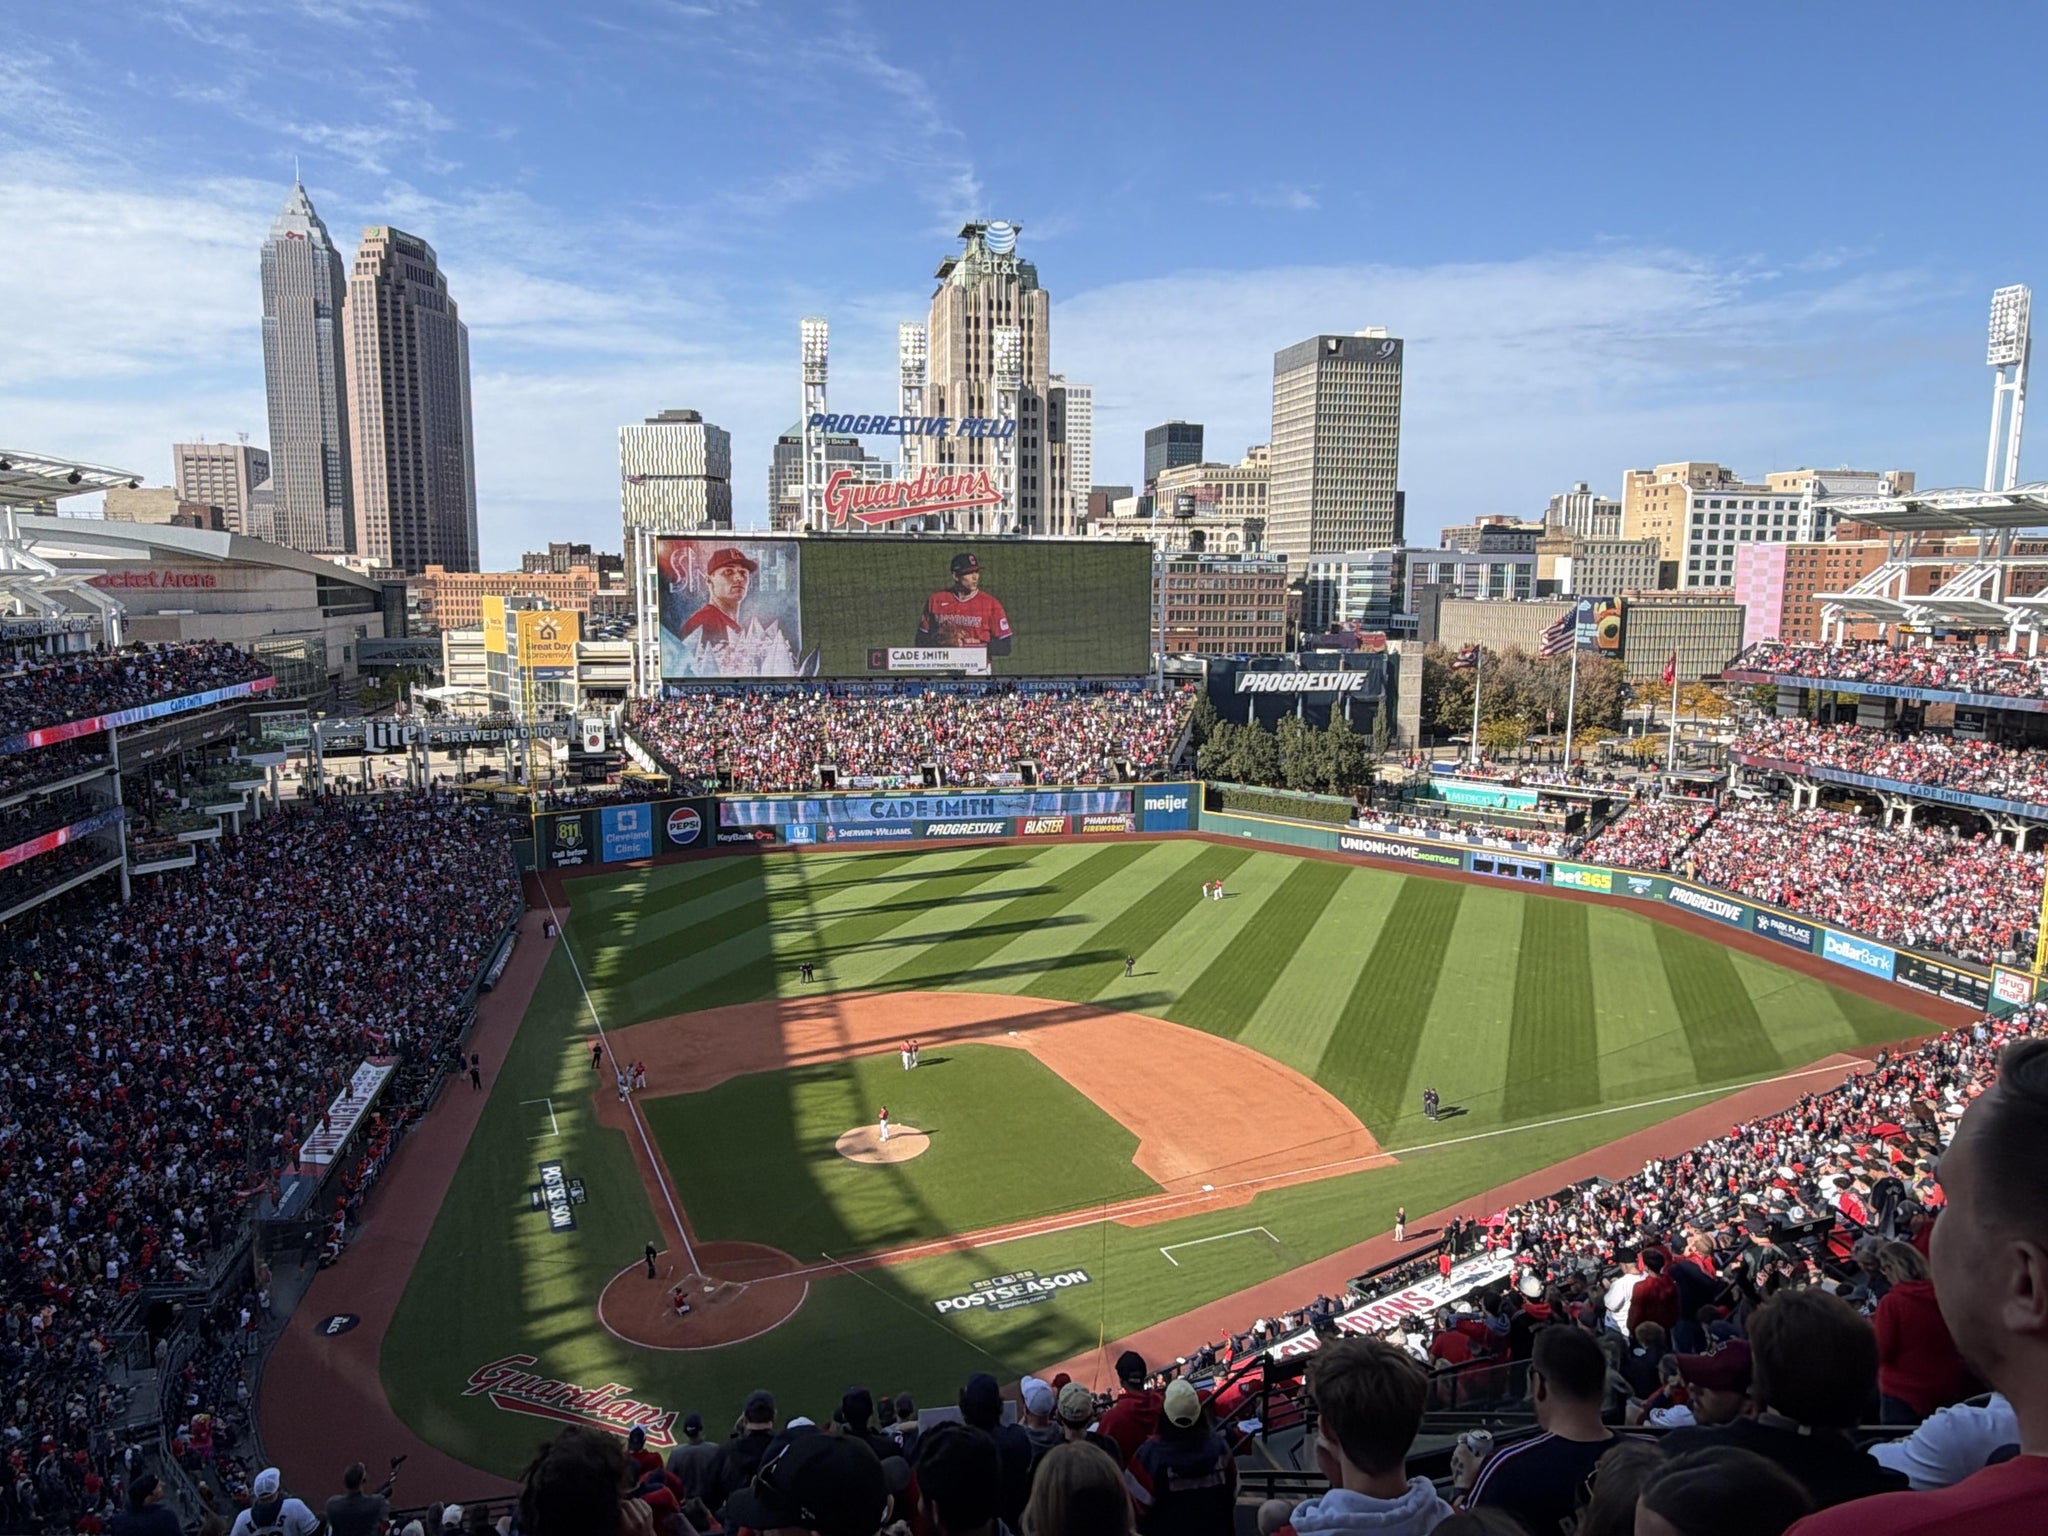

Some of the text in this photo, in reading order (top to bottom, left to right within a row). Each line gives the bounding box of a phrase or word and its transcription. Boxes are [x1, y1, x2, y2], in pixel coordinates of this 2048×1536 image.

[982, 257, 1021, 275] at&t
[1376, 340, 1396, 360] 9
[805, 413, 1016, 438] PROGRESSIVE FIELD
[823, 466, 1004, 527] Guardians
[162, 570, 216, 588] Arena
[554, 642, 572, 651] Day
[892, 650, 949, 660] CADE SMITH
[682, 685, 735, 693] HONDA
[1029, 682, 1075, 690] HONDA
[1239, 672, 1367, 692] PROGRESSIVE
[1866, 685, 1924, 698] CADE SMITH
[480, 719, 516, 728] PROUDLY
[586, 724, 603, 734] Lite
[363, 722, 418, 753] Lite
[442, 726, 551, 743] BREWED IN OHIO
[1909, 786, 1972, 804] CADE SMITH
[870, 799, 994, 819] CADE SMITH
[1144, 795, 1188, 813] meijer
[669, 820, 699, 831] PEPSI
[926, 822, 1005, 836] PROGRESSIVE
[1024, 818, 1065, 835] BLASTER
[1083, 824, 1125, 832] FIREWORKS
[1084, 816, 1126, 825] PHANTOM
[559, 824, 578, 839] 811
[606, 830, 650, 842] Cleveland
[717, 832, 754, 842] KeyBank
[615, 844, 641, 854] Clinic
[1554, 866, 1611, 889] bet365
[1669, 886, 1743, 921] PROGRESSIVE
[1770, 919, 1810, 938] PARK PLACE
[1998, 974, 2025, 993] drug
[542, 1165, 572, 1228] POSTSEASON
[935, 1270, 1088, 1314] POSTSEASON
[461, 1353, 679, 1448] Guardians
